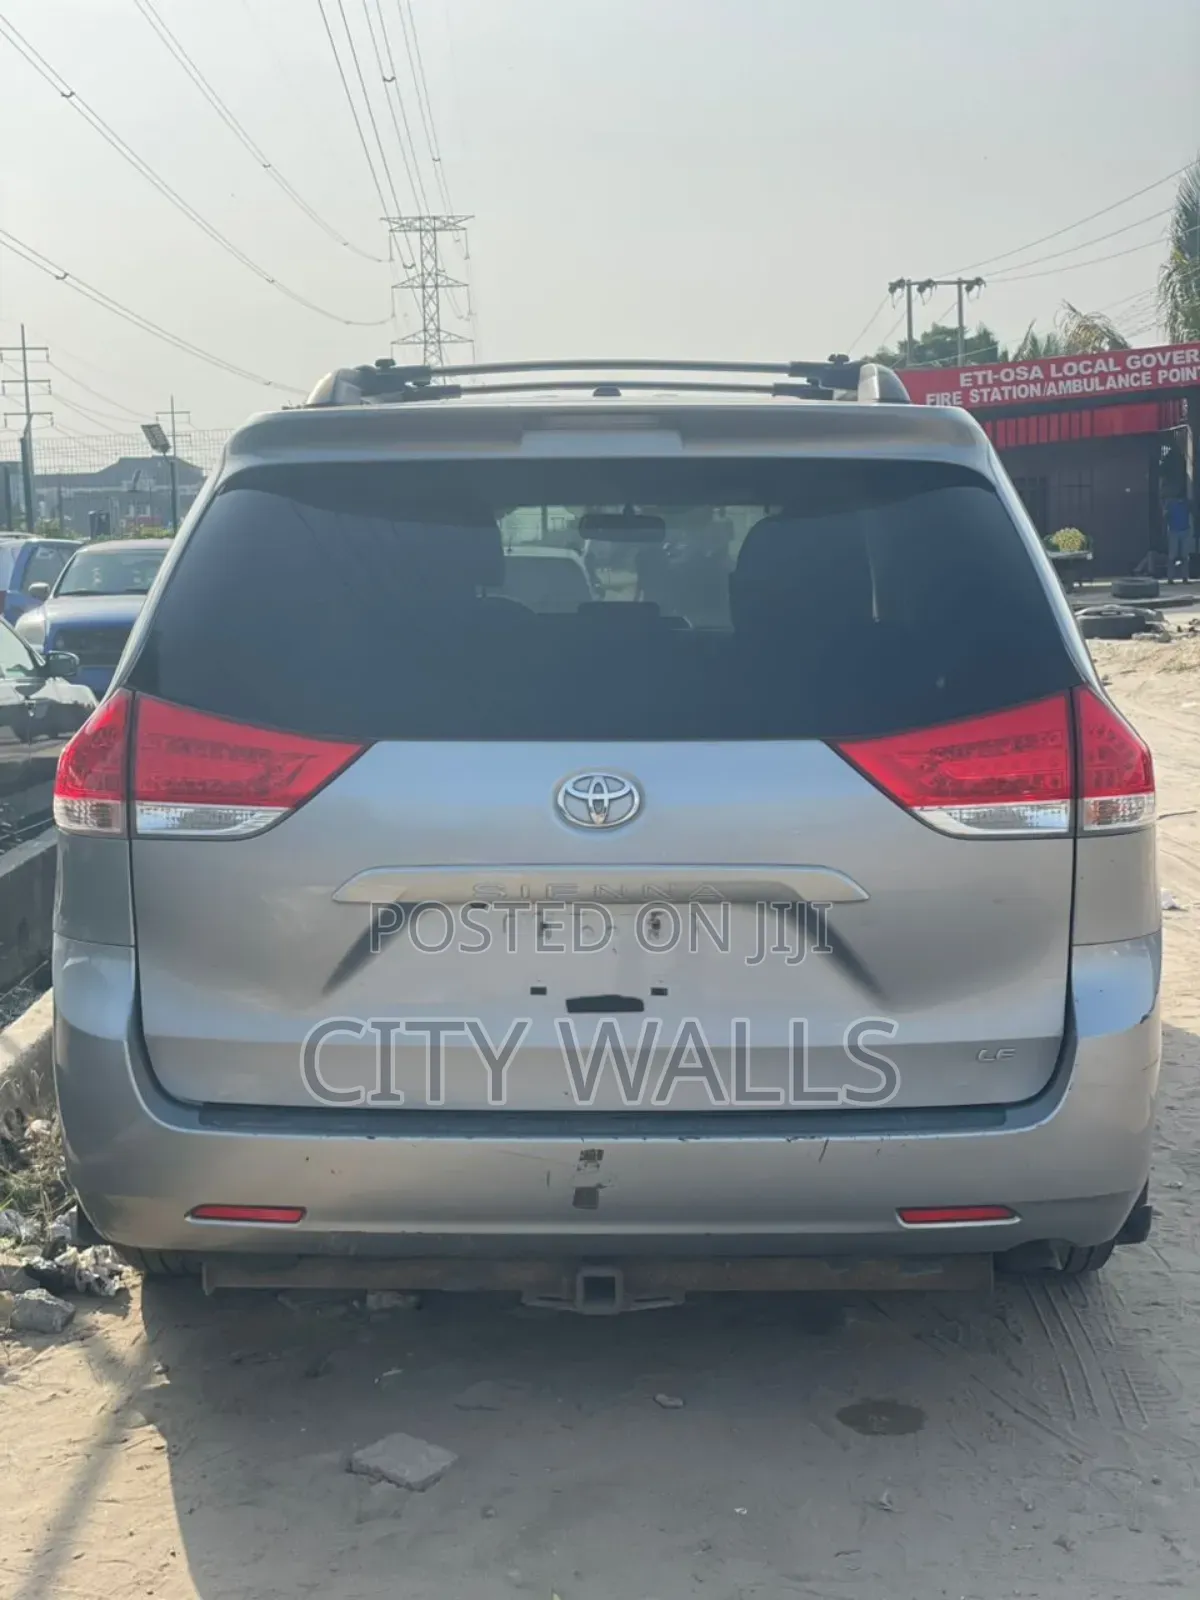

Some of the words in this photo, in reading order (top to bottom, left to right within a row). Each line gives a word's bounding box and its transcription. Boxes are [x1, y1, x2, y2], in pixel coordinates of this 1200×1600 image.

[959, 365, 1044, 388] ETI-OSA
[1050, 358, 1121, 378] LOCAL
[925, 390, 963, 406] FIRE
[472, 882, 725, 900] SIENNA
